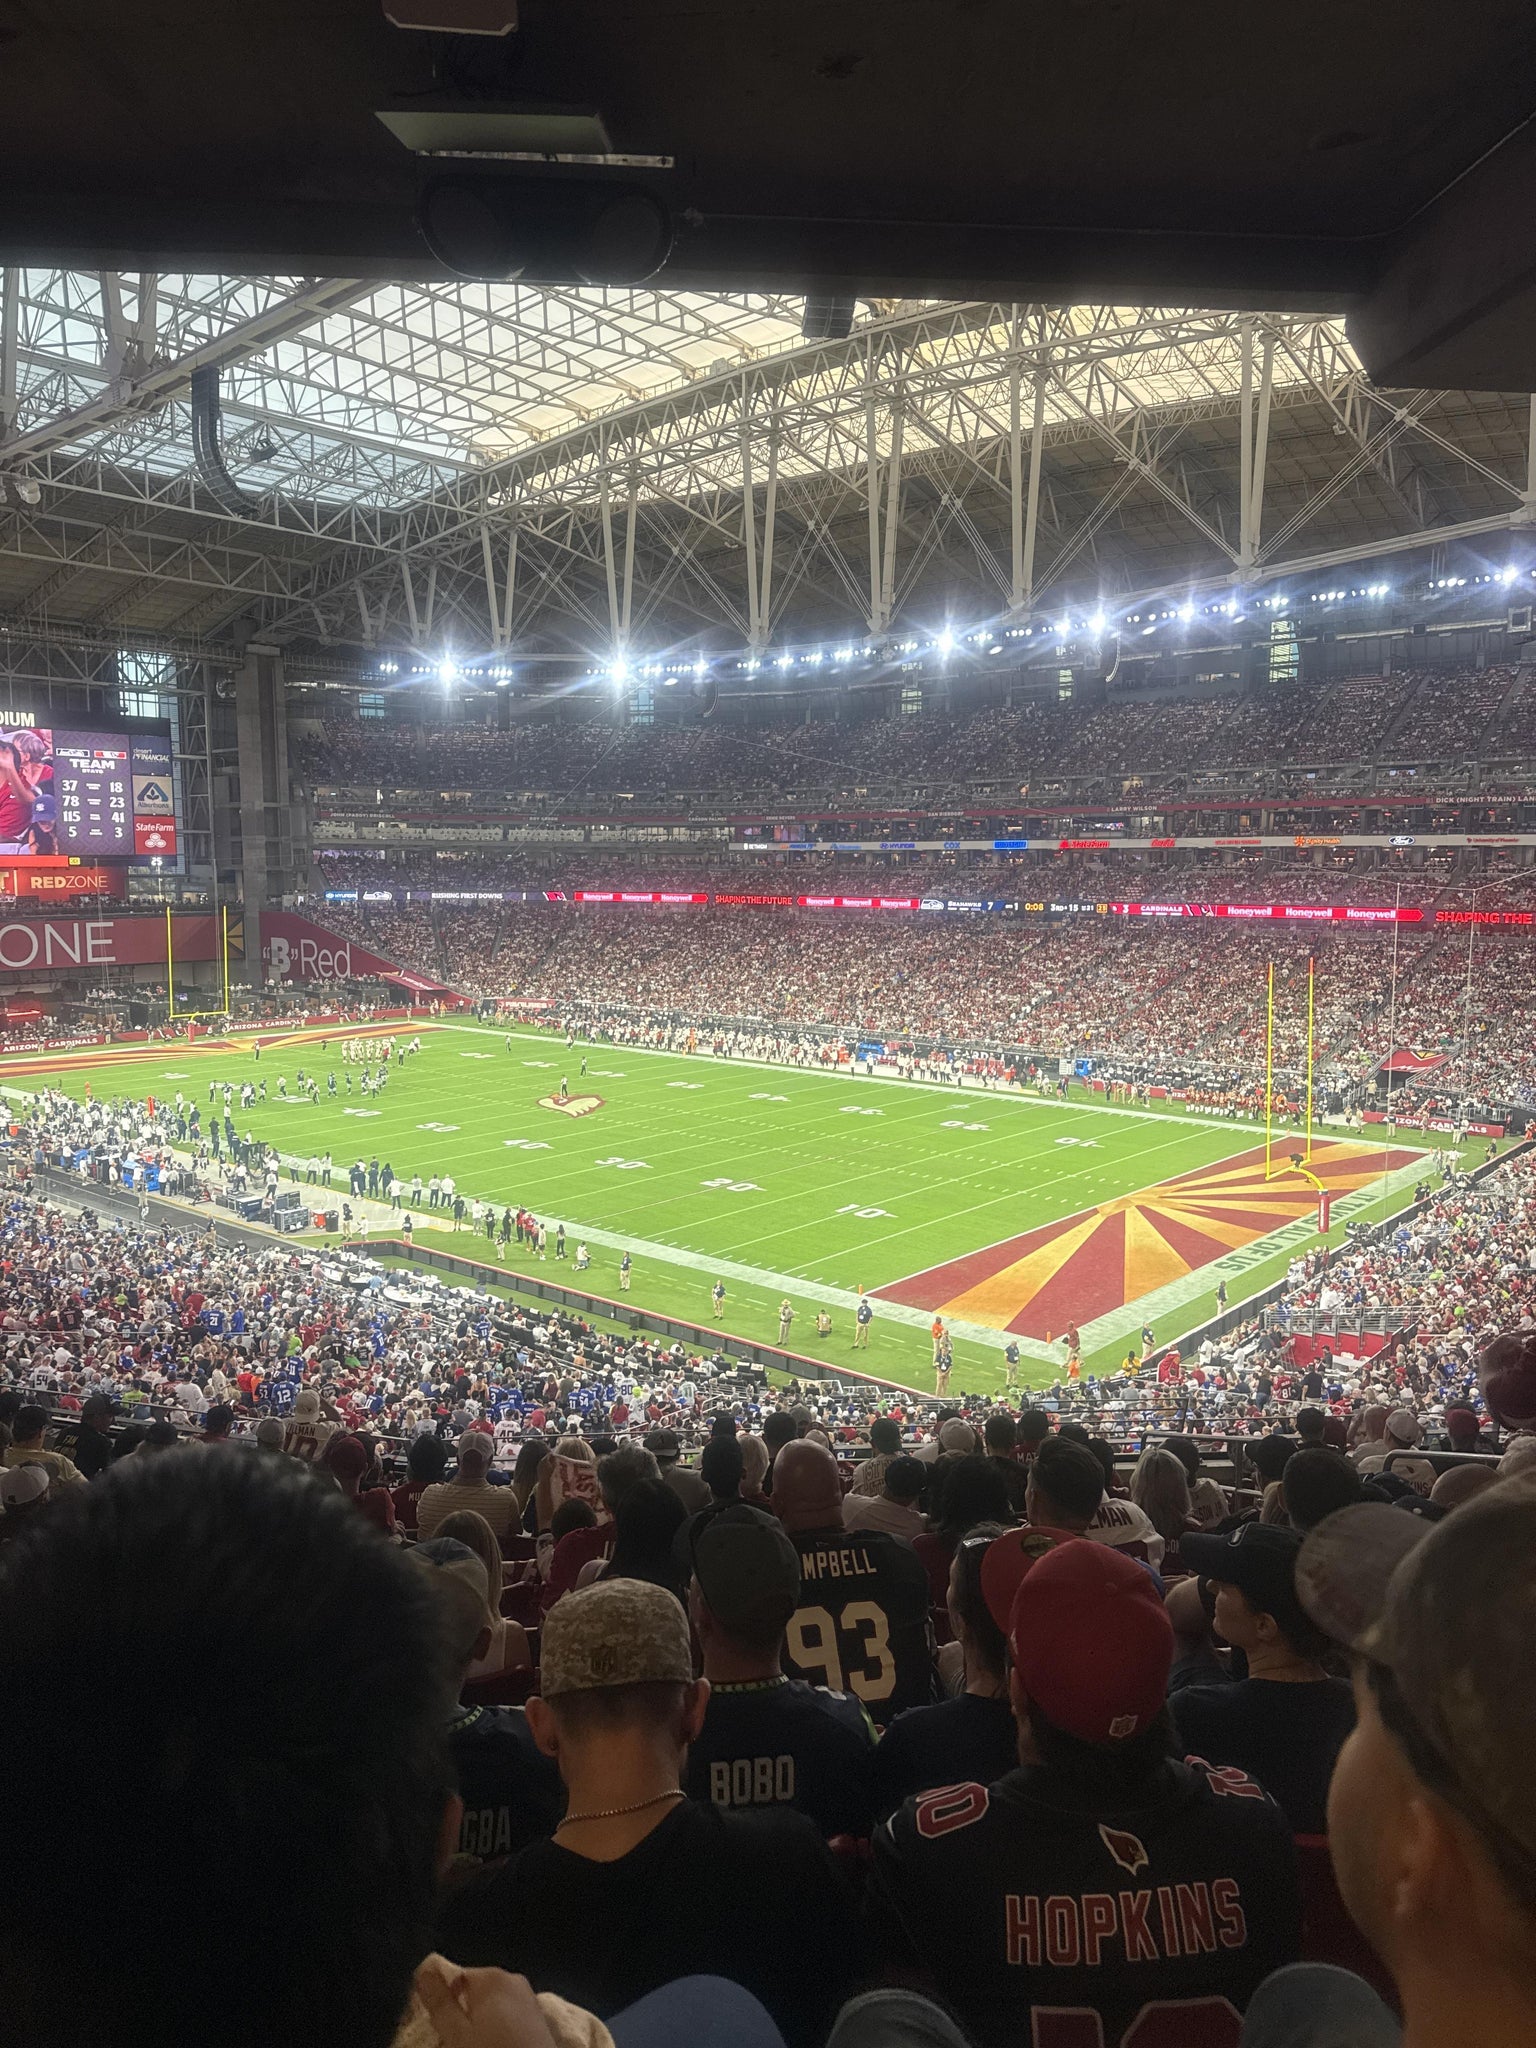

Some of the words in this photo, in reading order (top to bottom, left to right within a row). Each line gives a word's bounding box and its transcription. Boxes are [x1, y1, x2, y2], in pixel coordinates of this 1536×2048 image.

[69, 758, 115, 769] TEAM
[62, 780, 78, 791] 37
[109, 782, 123, 793] 18
[62, 795, 80, 807] 78
[109, 797, 125, 808] 23
[63, 811, 81, 822] 115
[111, 812, 125, 823] 41
[68, 826, 77, 837] 5
[114, 827, 123, 838] 3
[715, 895, 746, 904] SHAPING
[747, 895, 761, 904] THE
[762, 896, 792, 905] FUTURE
[1227, 906, 1272, 917] Honeywell
[1285, 908, 1332, 918] Honeywell
[1347, 910, 1396, 919] Honeywell
[1436, 911, 1500, 924] SHAPING
[1503, 912, 1533, 925] THE
[229, 1021, 264, 1030] ARIZONA
[3, 1043, 39, 1052] ARIZON
[1382, 1115, 1423, 1126] AIZONA
[416, 1121, 461, 1132] 50
[502, 1138, 548, 1150] 40
[594, 1157, 646, 1169] 30
[700, 1178, 757, 1192] 20
[1214, 1255, 1261, 1271] US
[209, 1316, 218, 1326] 21
[36, 1373, 48, 1386] 54
[621, 1385, 633, 1395] 80
[277, 1390, 291, 1404] 12
[799, 1549, 877, 1580] MPBELL
[785, 1601, 897, 1701] 93
[710, 1755, 796, 1806] BOBO
[1005, 1878, 1247, 1967] HOPKINS
